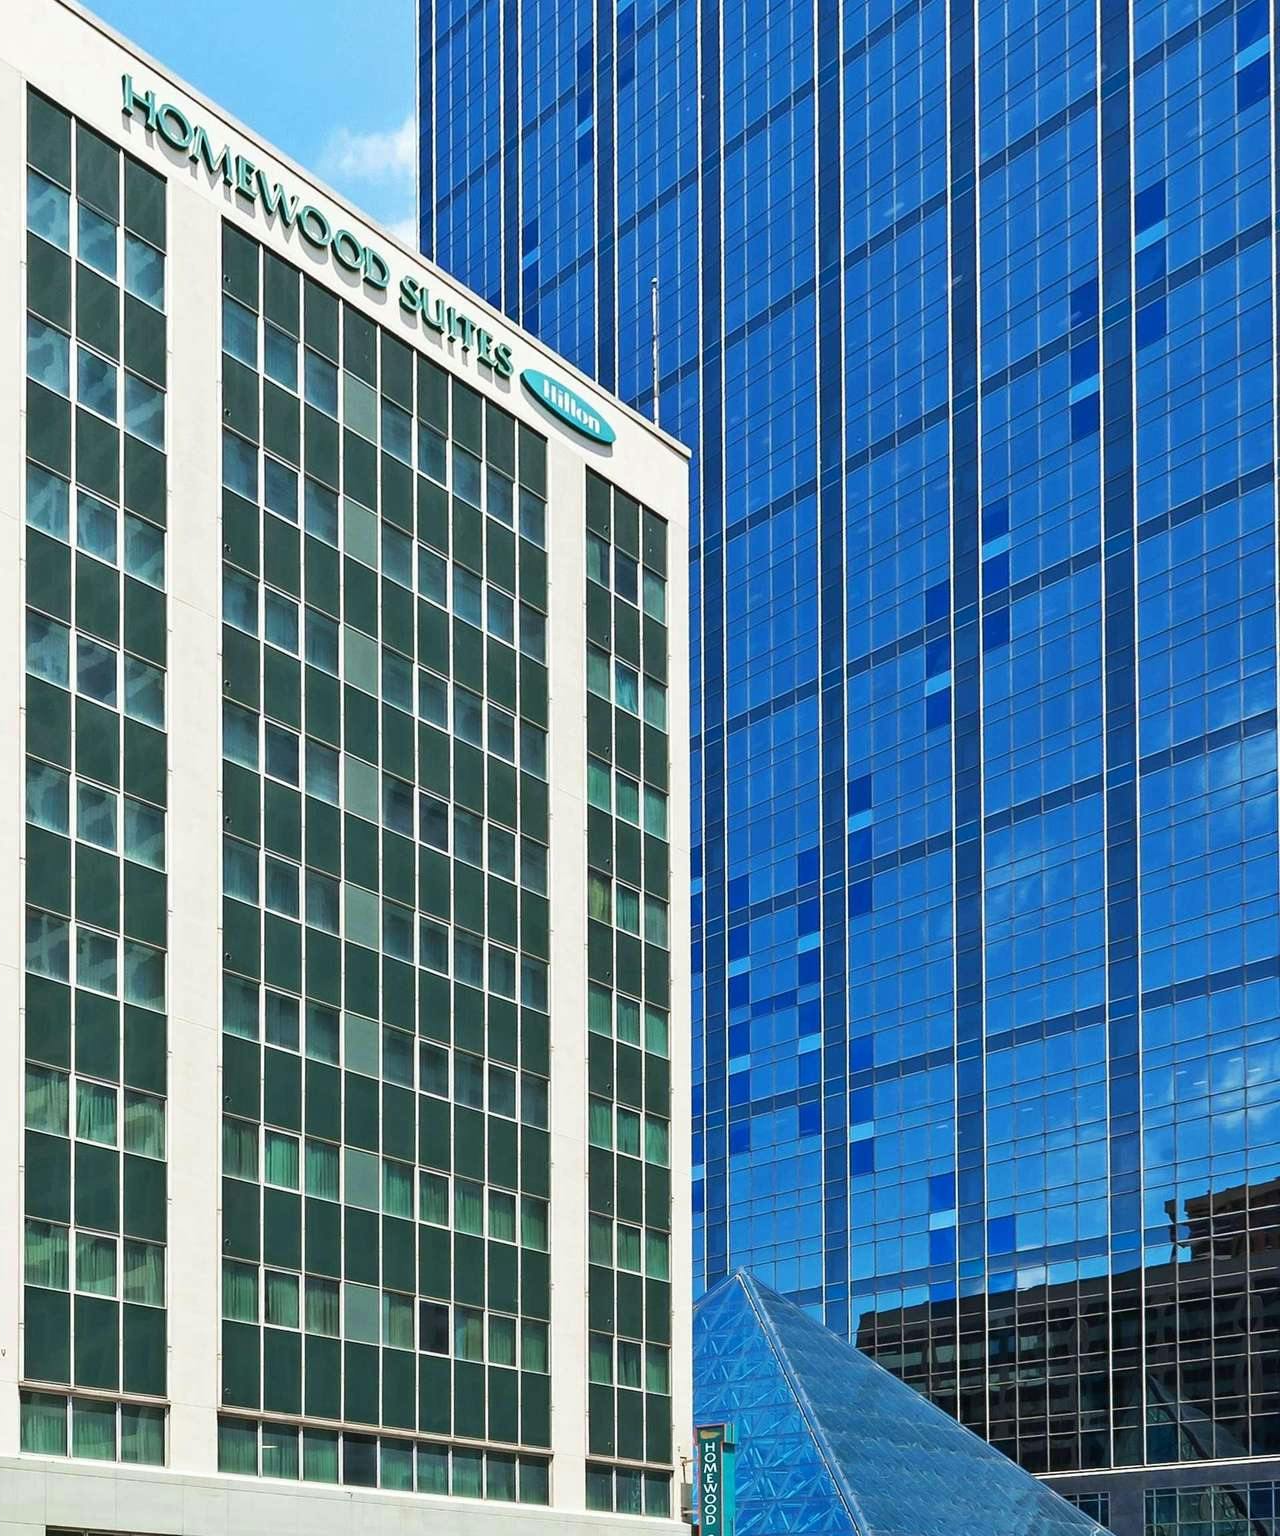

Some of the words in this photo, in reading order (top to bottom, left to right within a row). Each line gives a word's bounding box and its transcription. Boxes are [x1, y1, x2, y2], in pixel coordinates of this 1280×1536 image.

[121, 73, 391, 289] HOMEWOOD
[399, 275, 513, 379] SUITES
[543, 379, 600, 434] Hilton
[703, 1442, 717, 1525] HOMEWOOD
